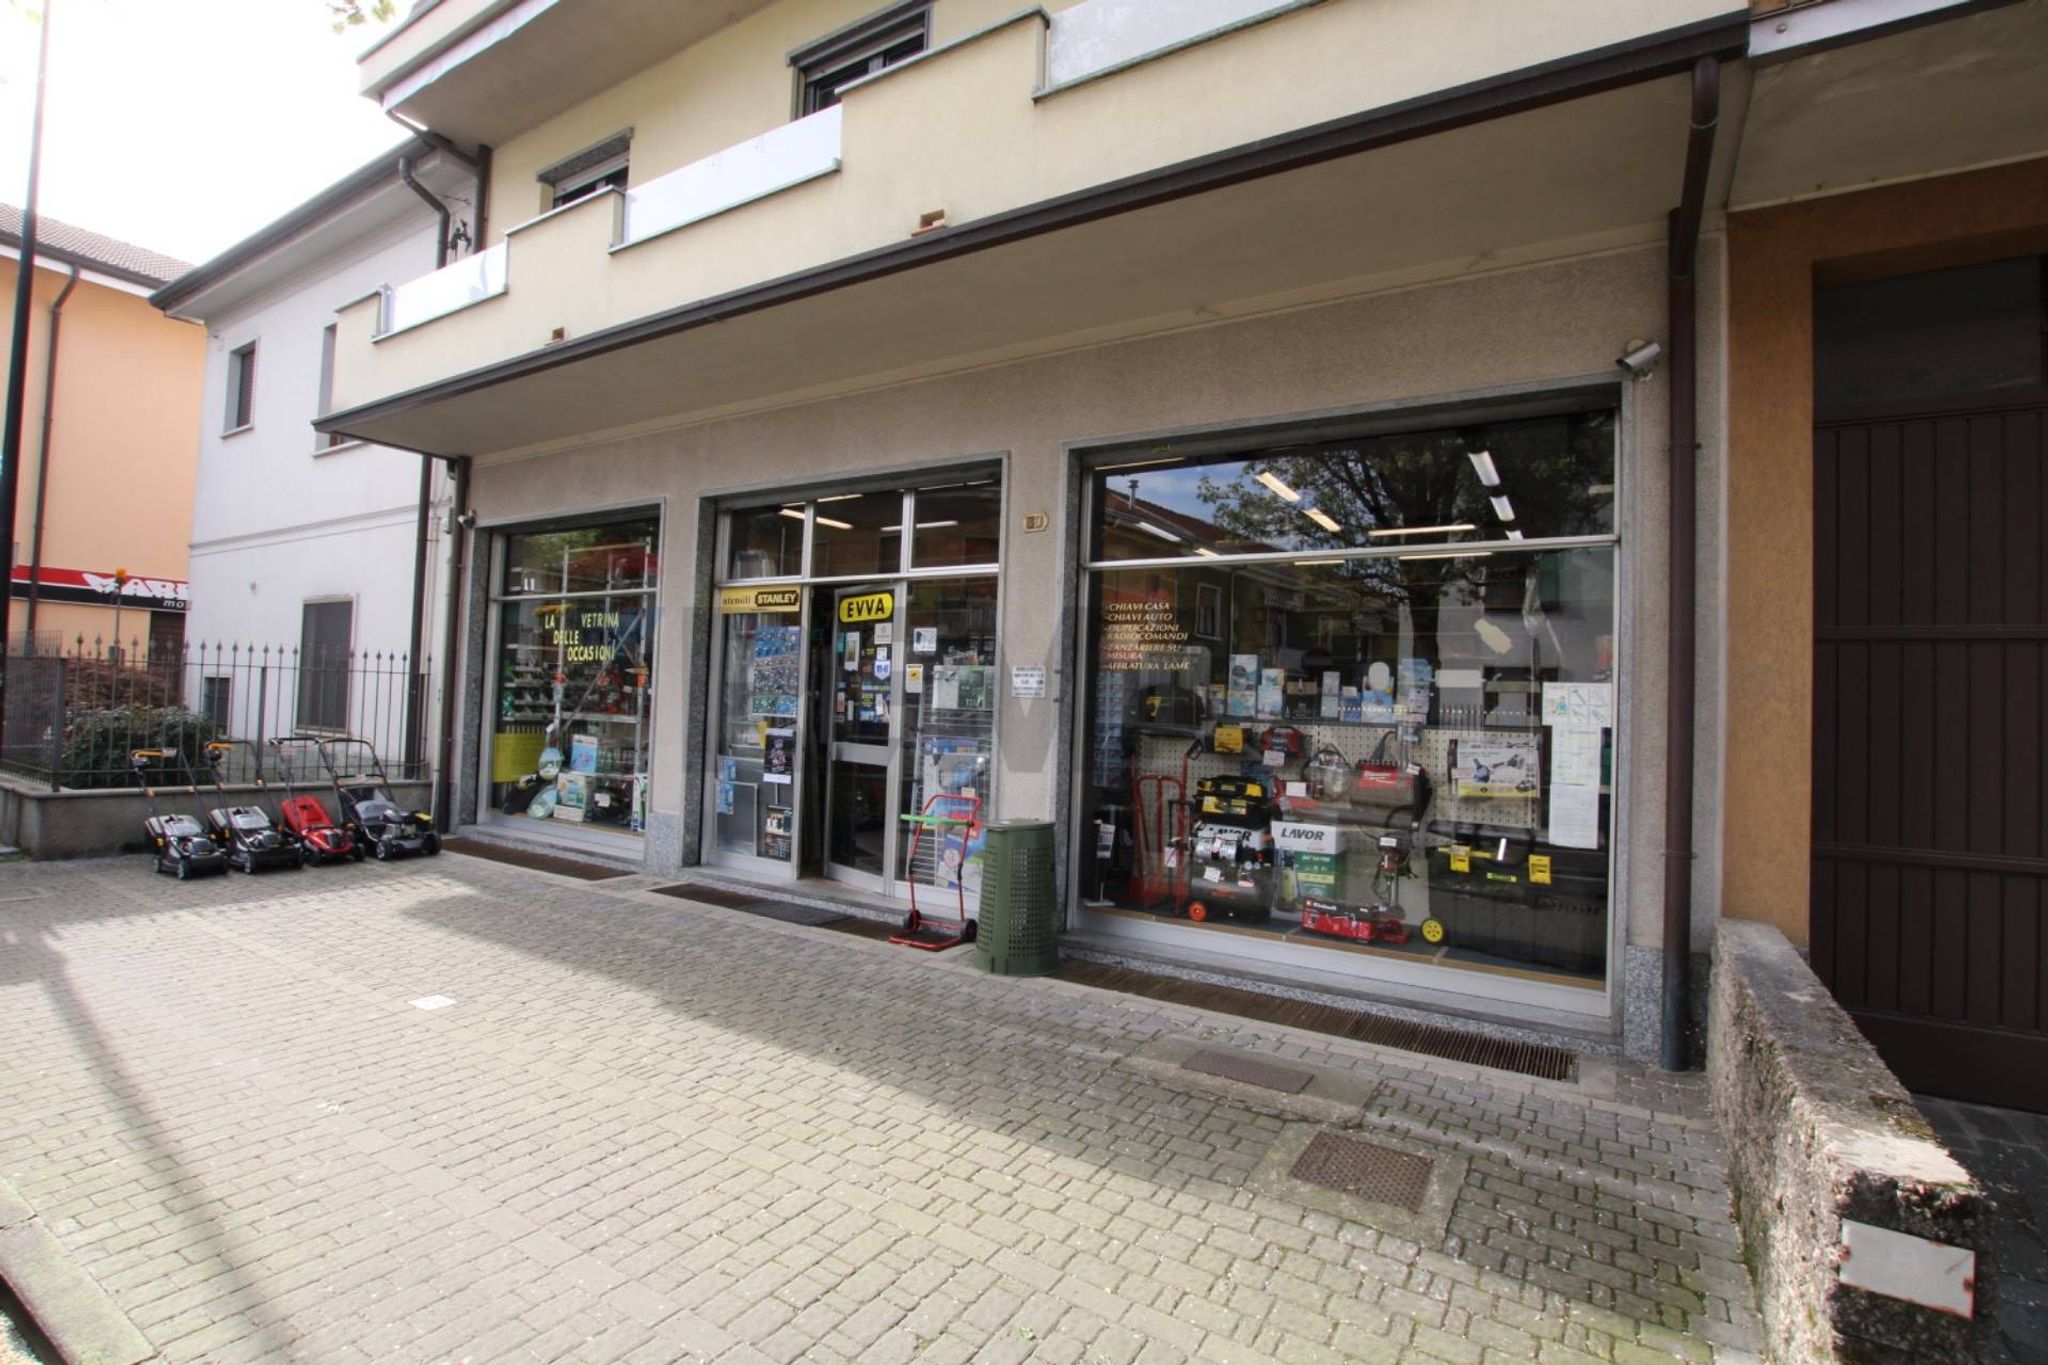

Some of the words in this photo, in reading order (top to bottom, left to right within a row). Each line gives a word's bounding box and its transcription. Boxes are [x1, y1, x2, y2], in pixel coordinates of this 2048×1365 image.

[757, 592, 796, 605] STANLEY
[847, 598, 885, 619] EVVA
[1144, 602, 1170, 611] CASA
[545, 614, 555, 629] LA
[582, 612, 619, 628] VETRINA
[1143, 613, 1173, 621] AUTO
[553, 630, 579, 645] DELLE
[567, 646, 615, 661] OCCASIONI
[1163, 660, 1190, 670] LAME
[1281, 828, 1324, 841] LAVOR
